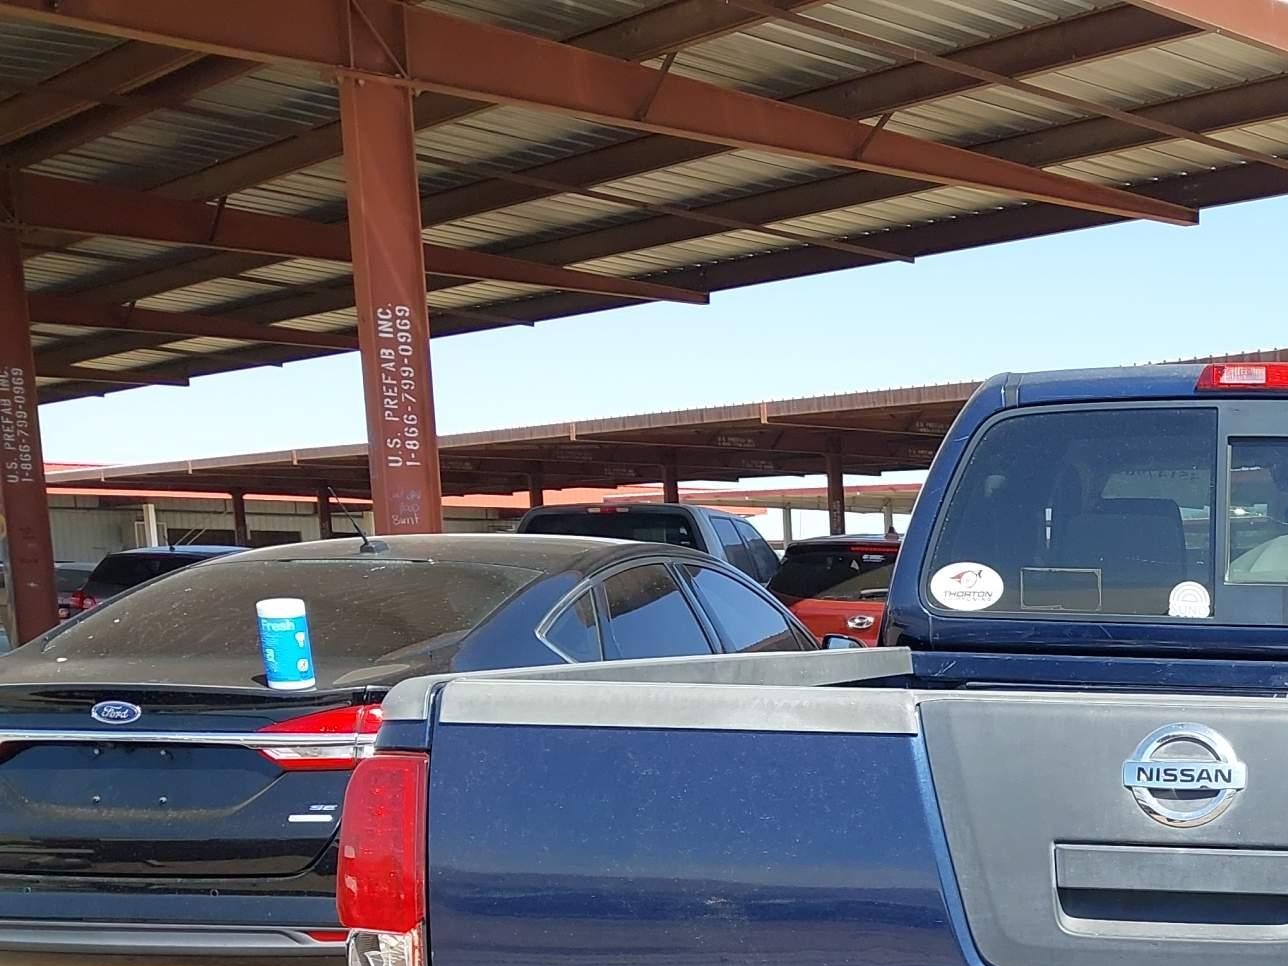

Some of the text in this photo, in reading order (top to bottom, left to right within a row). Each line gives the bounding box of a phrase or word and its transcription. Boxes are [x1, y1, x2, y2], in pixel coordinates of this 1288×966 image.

[377, 303, 403, 467] U.S. PREFAB INC.
[395, 305, 421, 466] 1-866-799-0969
[0, 398, 17, 450] PREFAB
[11, 367, 33, 482] 1-866-799-0969
[6, 456, 20, 483] U.S.
[943, 590, 993, 598] THORTON
[100, 704, 130, 719] Ford
[1136, 766, 1232, 784] NISSAN
